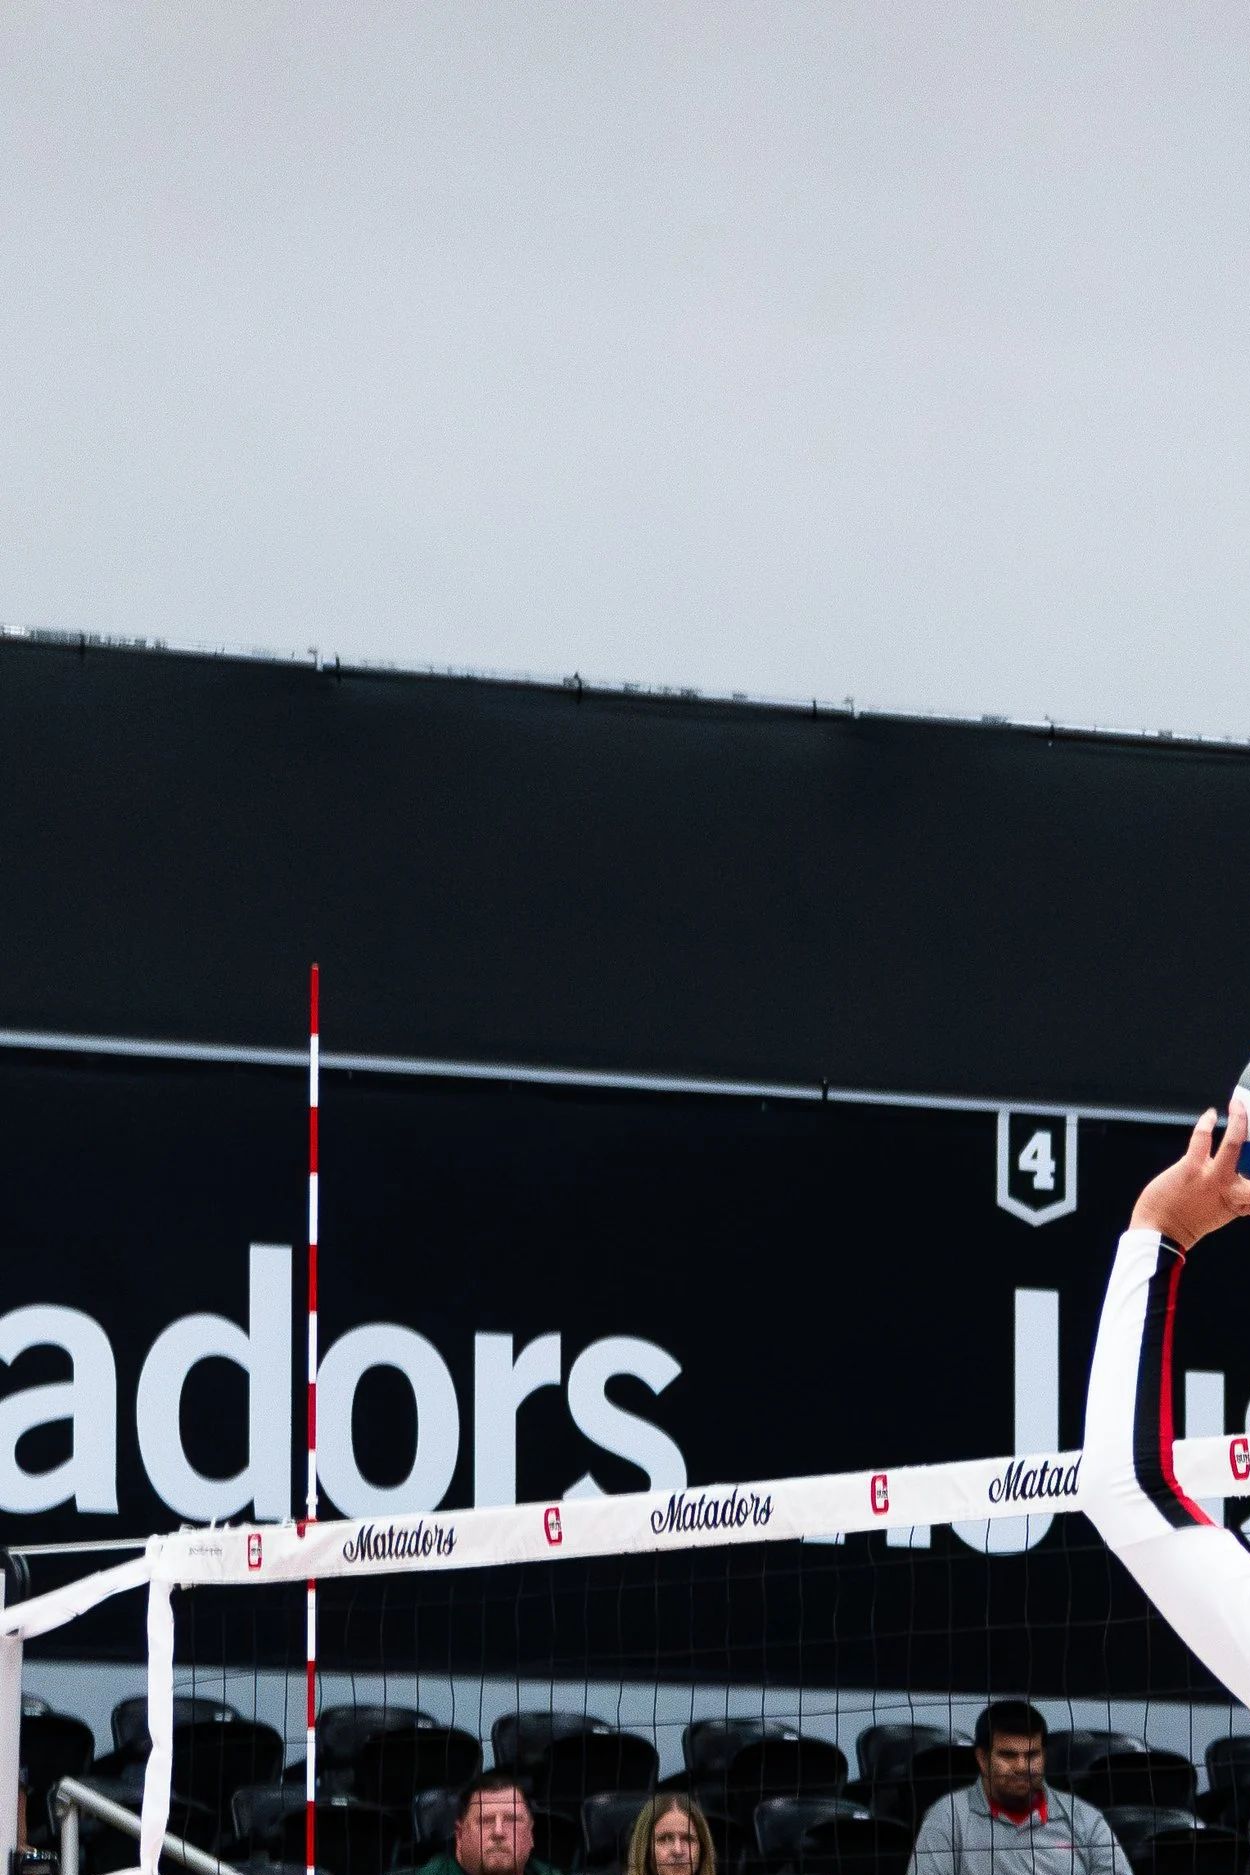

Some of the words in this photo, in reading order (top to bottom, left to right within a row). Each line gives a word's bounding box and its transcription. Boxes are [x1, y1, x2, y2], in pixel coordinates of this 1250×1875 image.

[1018, 1129, 1056, 1191] 4
[343, 1520, 457, 1562] Matadors
[650, 1489, 774, 1535] Matadors
